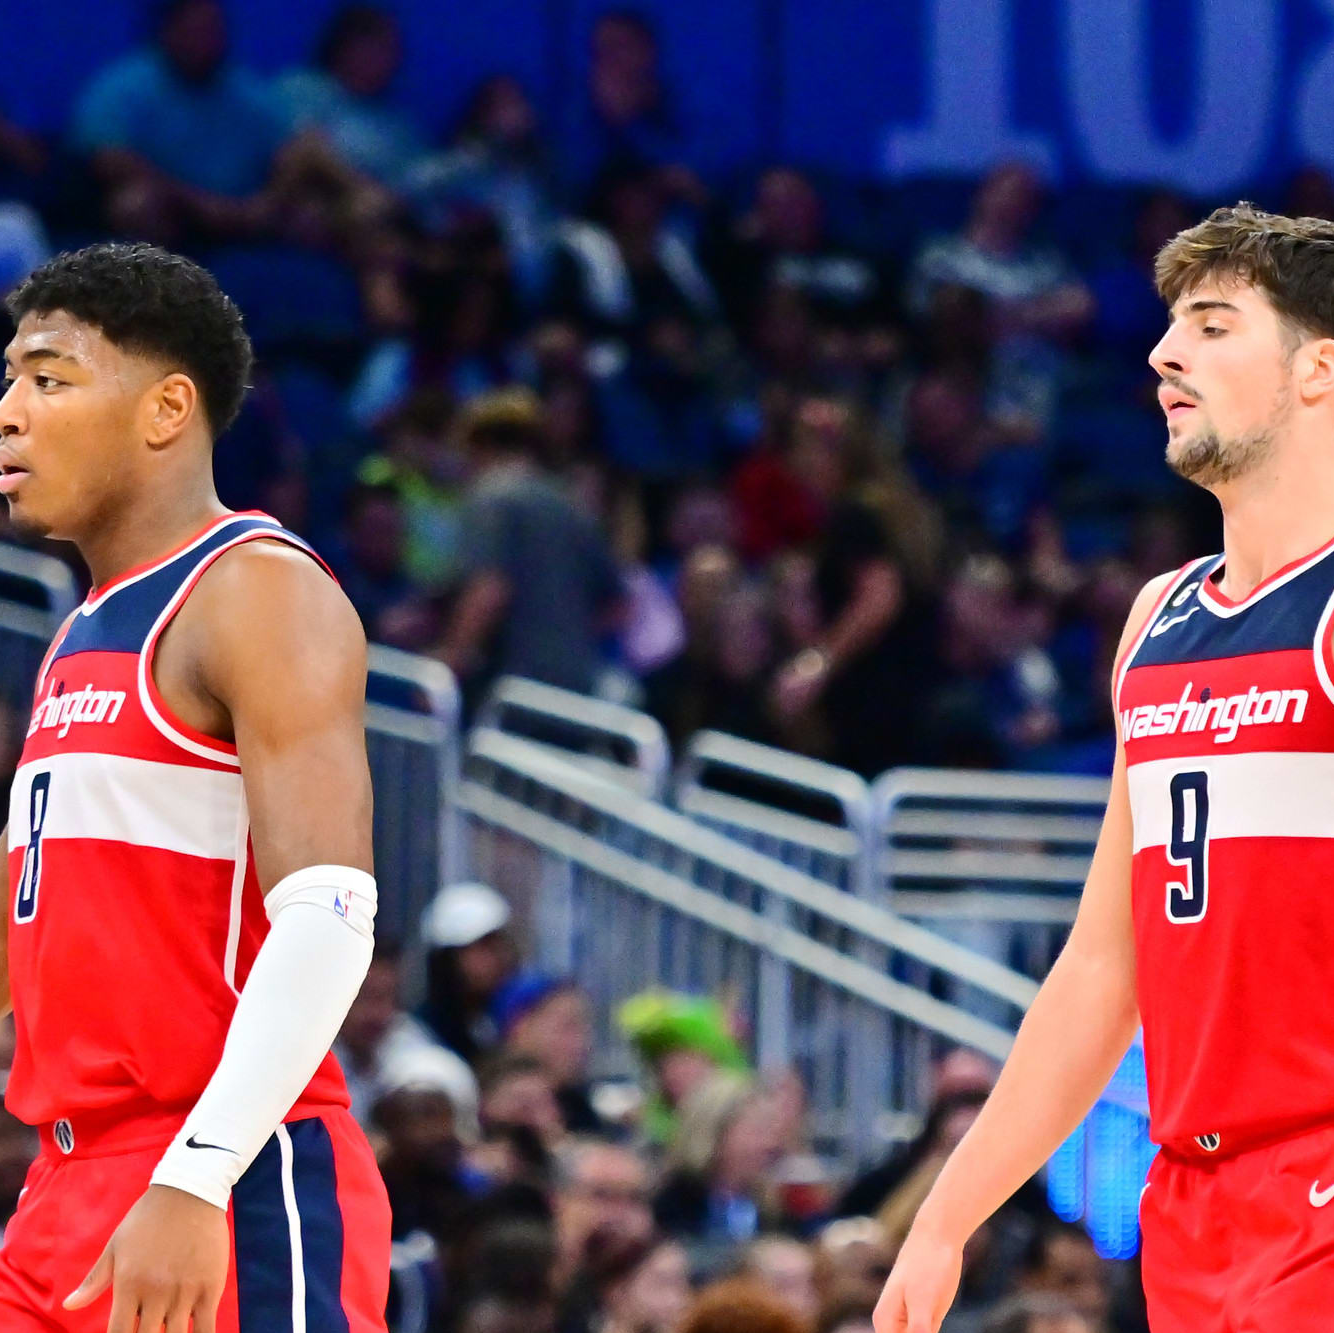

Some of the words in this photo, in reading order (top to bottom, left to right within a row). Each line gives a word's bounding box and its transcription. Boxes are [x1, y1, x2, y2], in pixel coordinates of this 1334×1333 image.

[26, 677, 127, 739] shington
[1120, 681, 1309, 744] washington
[14, 771, 51, 924] 8
[1165, 769, 1209, 924] 9
